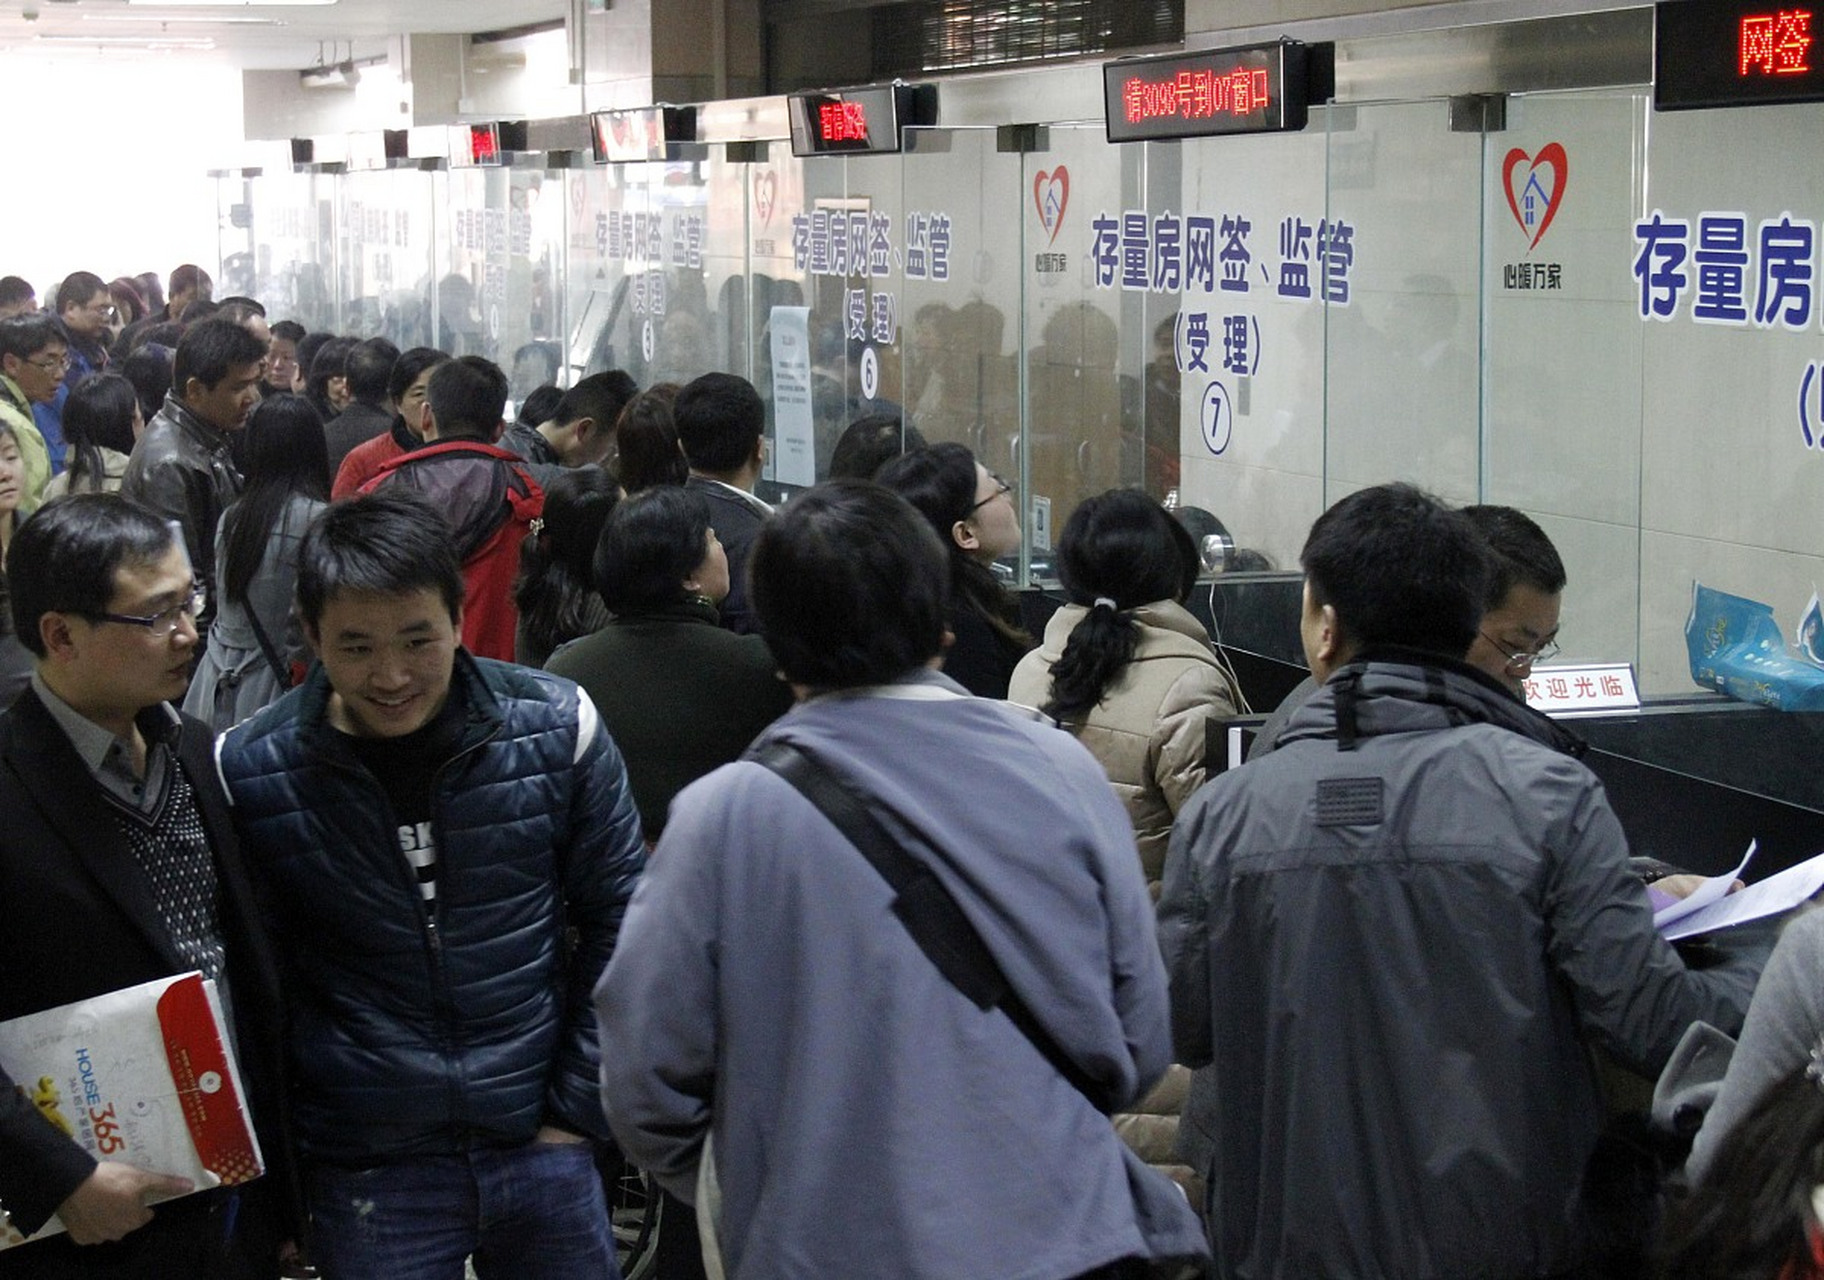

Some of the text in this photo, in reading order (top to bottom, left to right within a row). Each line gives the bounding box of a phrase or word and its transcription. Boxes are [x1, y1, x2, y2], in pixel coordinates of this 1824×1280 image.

[1742, 11, 1811, 75] 网签
[1125, 66, 1268, 123] 请3098号到07窗口
[1091, 212, 1355, 304] 存量房网签、监管
[1503, 262, 1562, 290] 心暖万家
[1634, 214, 1813, 327] 存量房
[1521, 674, 1624, 701] 欢迎光临
[76, 1047, 126, 1155] HOUSE 365
